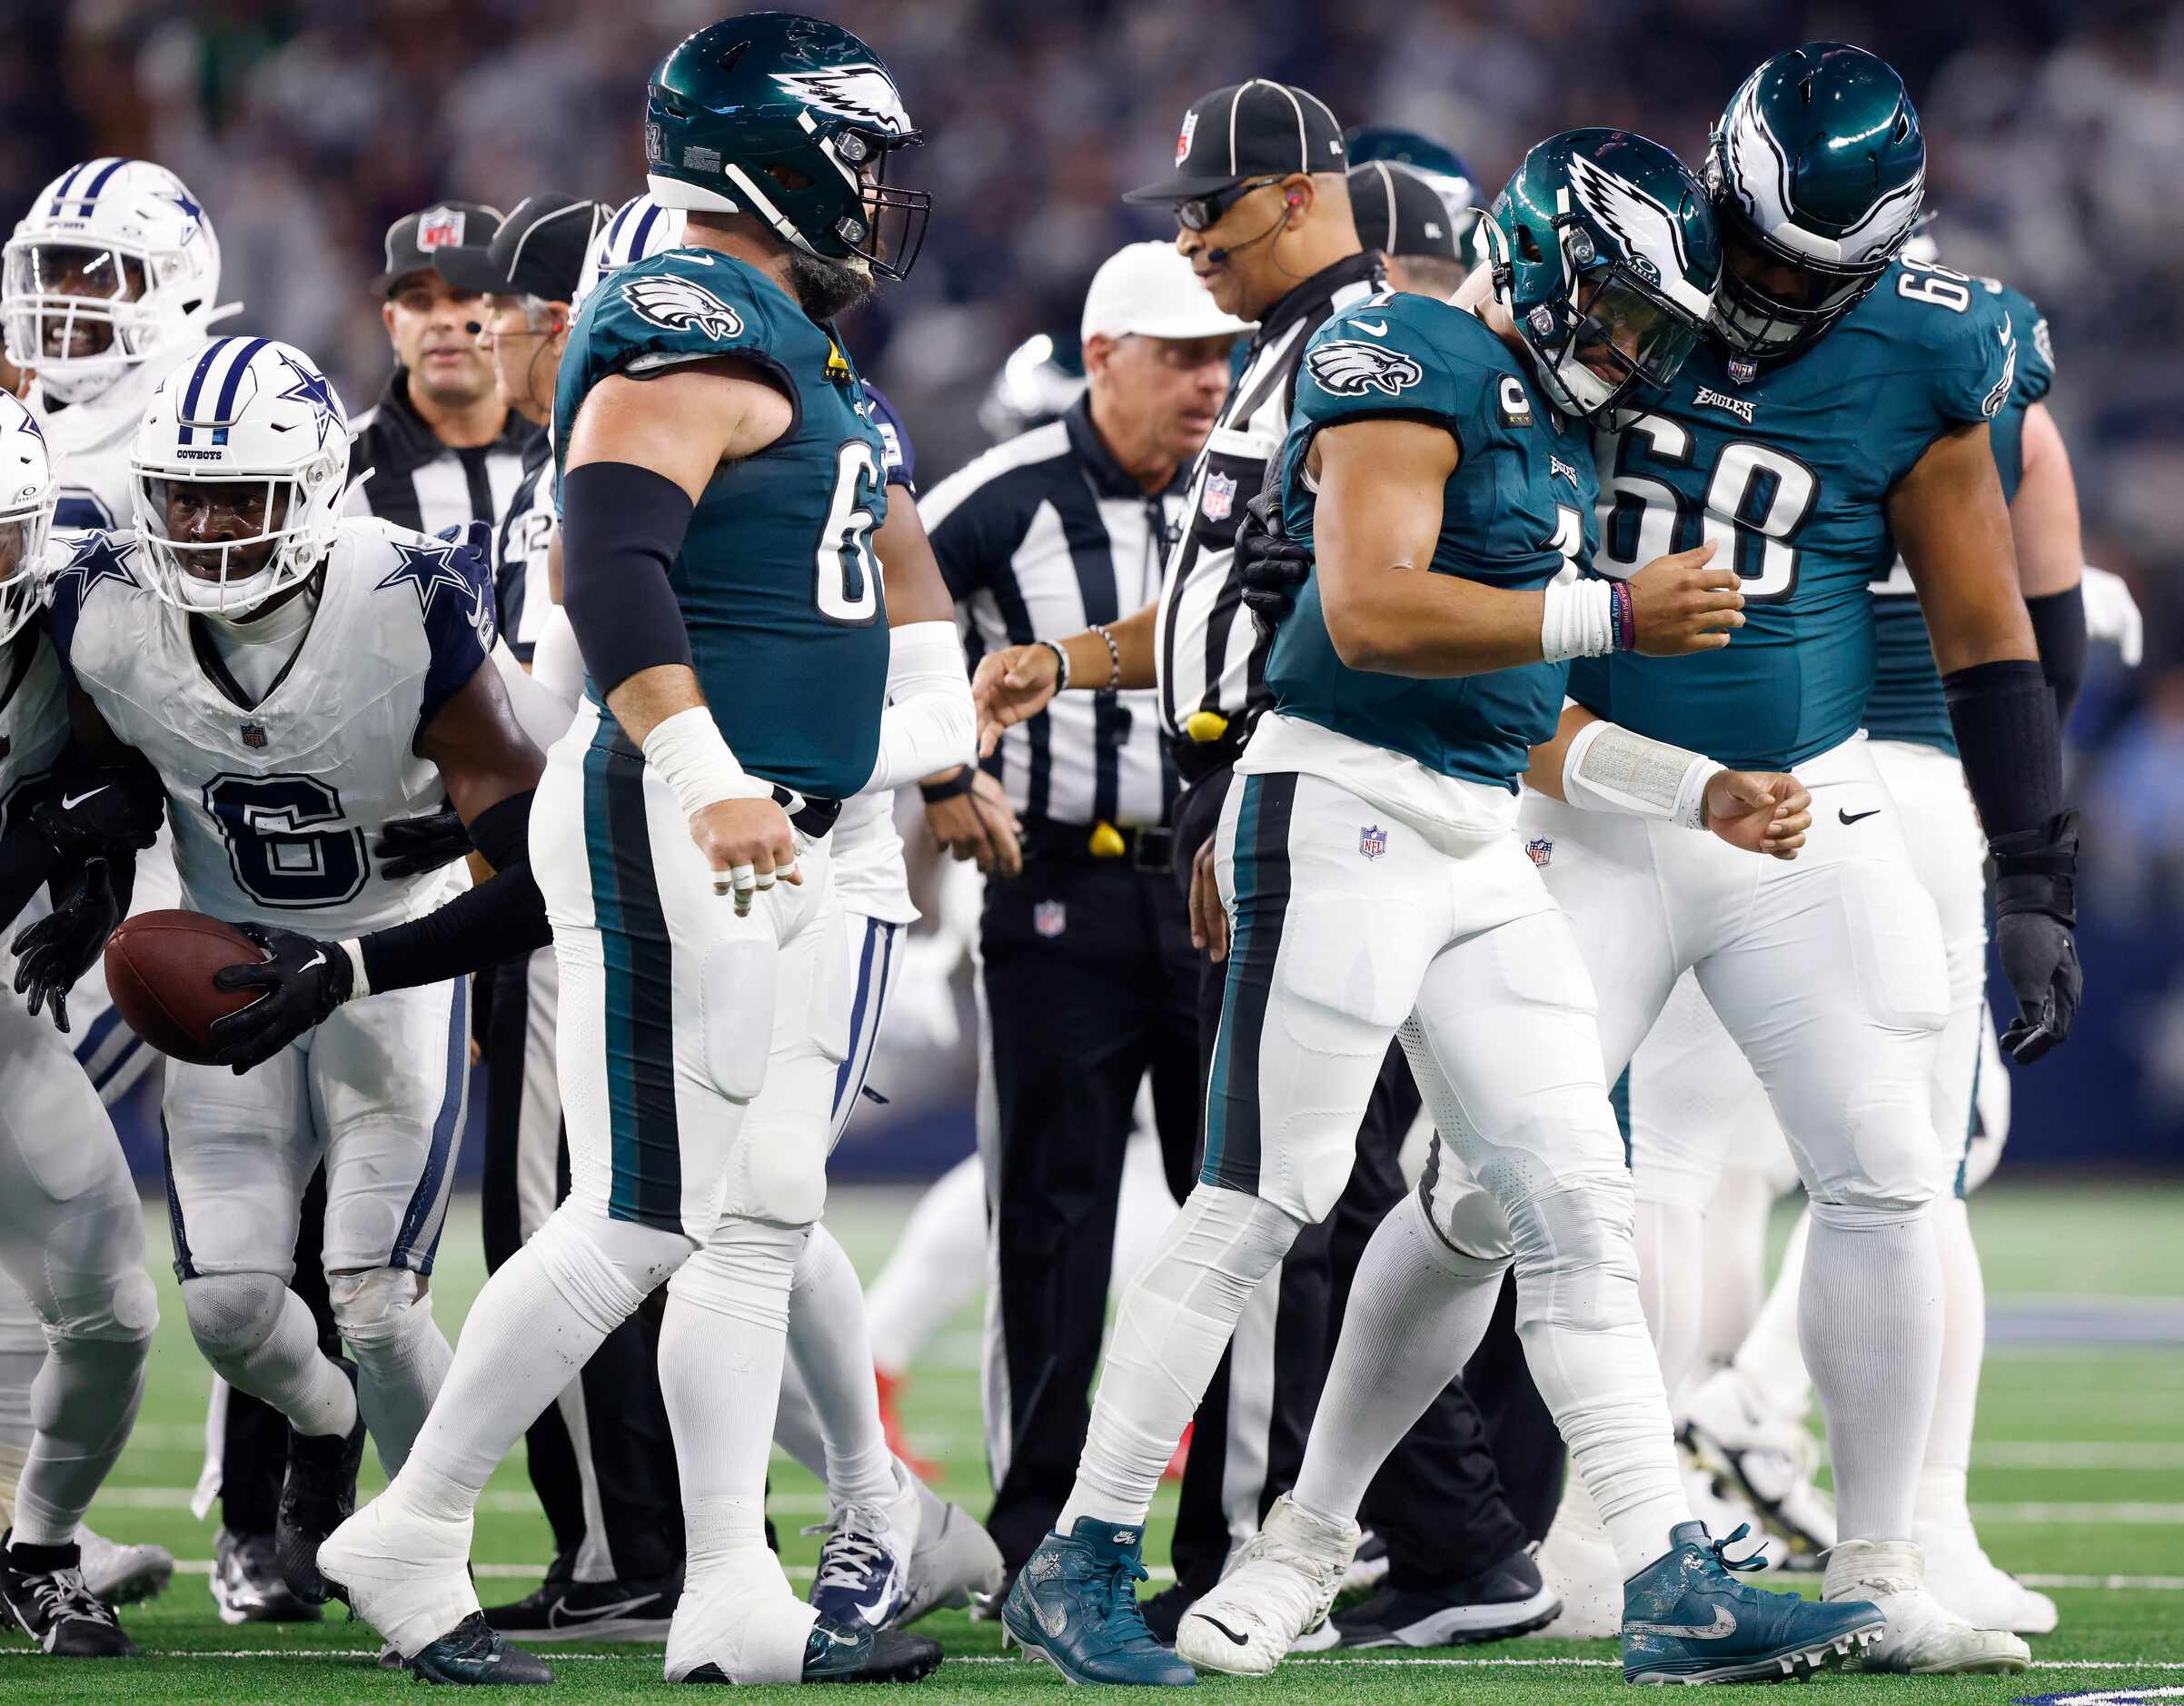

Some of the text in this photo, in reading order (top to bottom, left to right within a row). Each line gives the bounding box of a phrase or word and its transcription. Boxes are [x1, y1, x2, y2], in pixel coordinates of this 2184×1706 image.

[1627, 260, 1657, 283] OAKLEY
[1732, 363, 1754, 378] NFL
[1500, 377, 1530, 414] C
[1693, 385, 1759, 424] EAGLES
[176, 449, 223, 461] COWBOYS
[1592, 407, 1819, 601] 68
[815, 440, 887, 627] 6
[202, 772, 370, 908] 6
[1365, 839, 1383, 854] NFL
